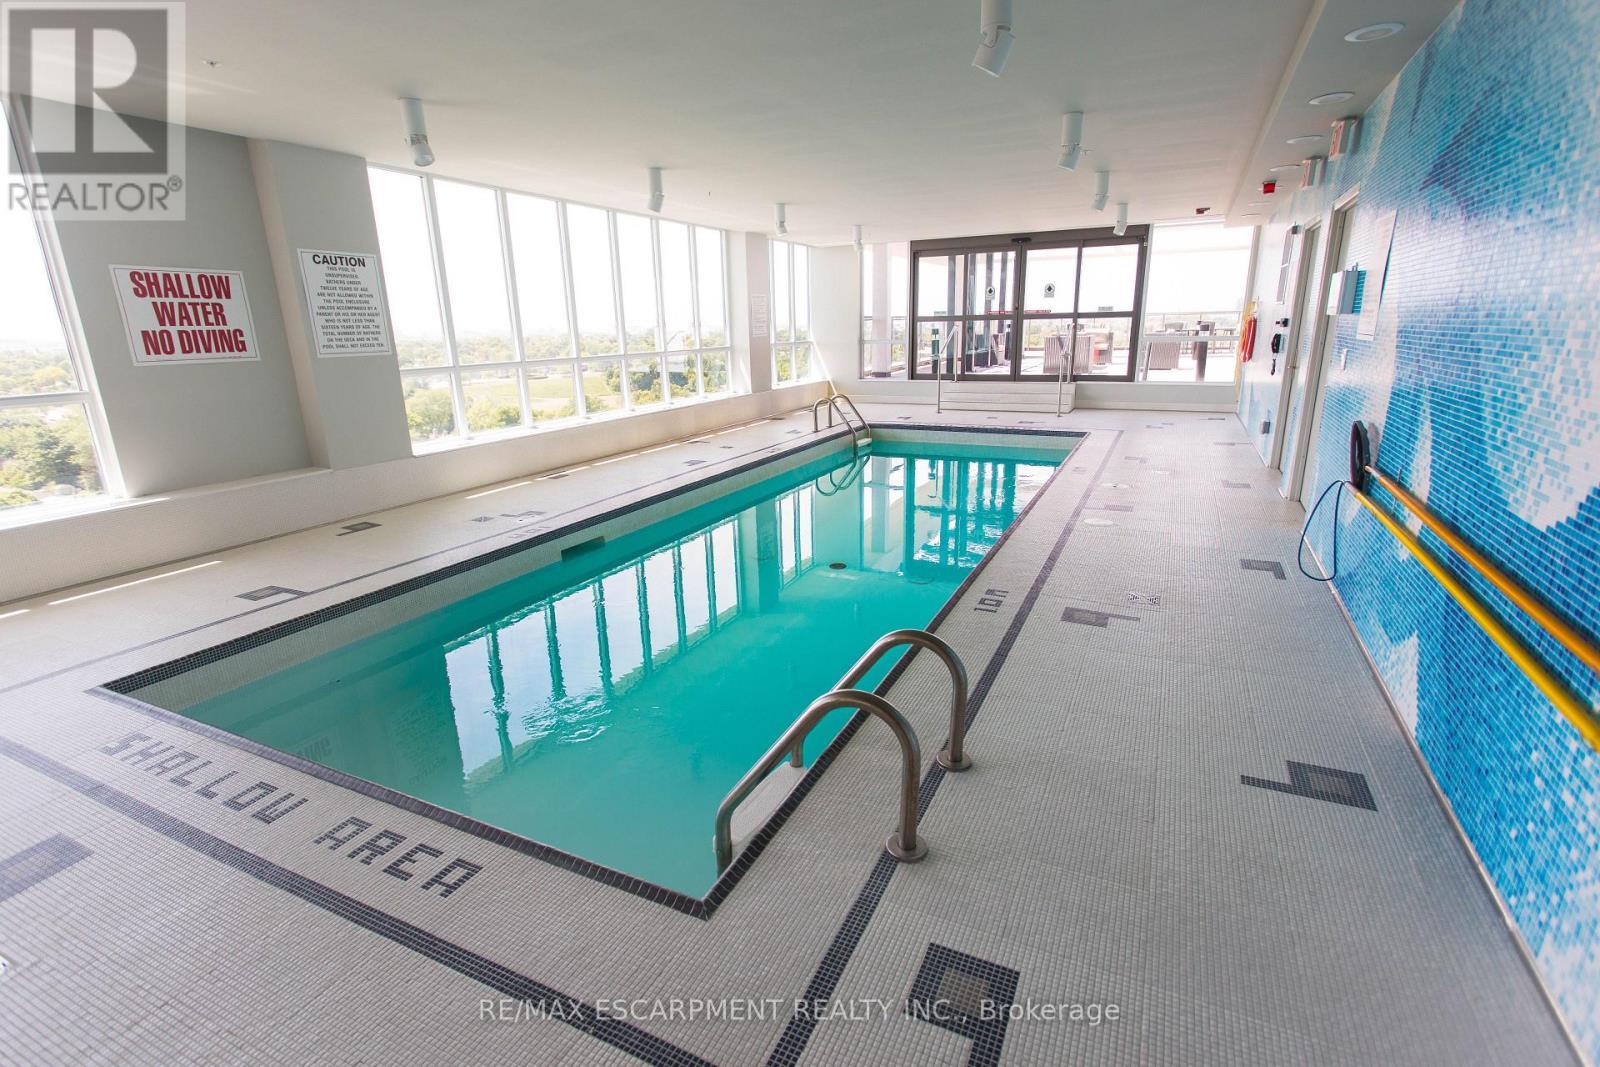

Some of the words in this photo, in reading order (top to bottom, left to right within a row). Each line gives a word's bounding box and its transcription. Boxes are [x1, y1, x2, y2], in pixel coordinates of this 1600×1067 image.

[312, 254, 366, 268] CAUTION
[129, 271, 232, 299] SHALLOW
[152, 301, 227, 326] WATER
[141, 329, 175, 355] NO
[177, 328, 247, 354] DIVING
[100, 731, 309, 825] SHALLOW
[312, 815, 484, 899] AREA
